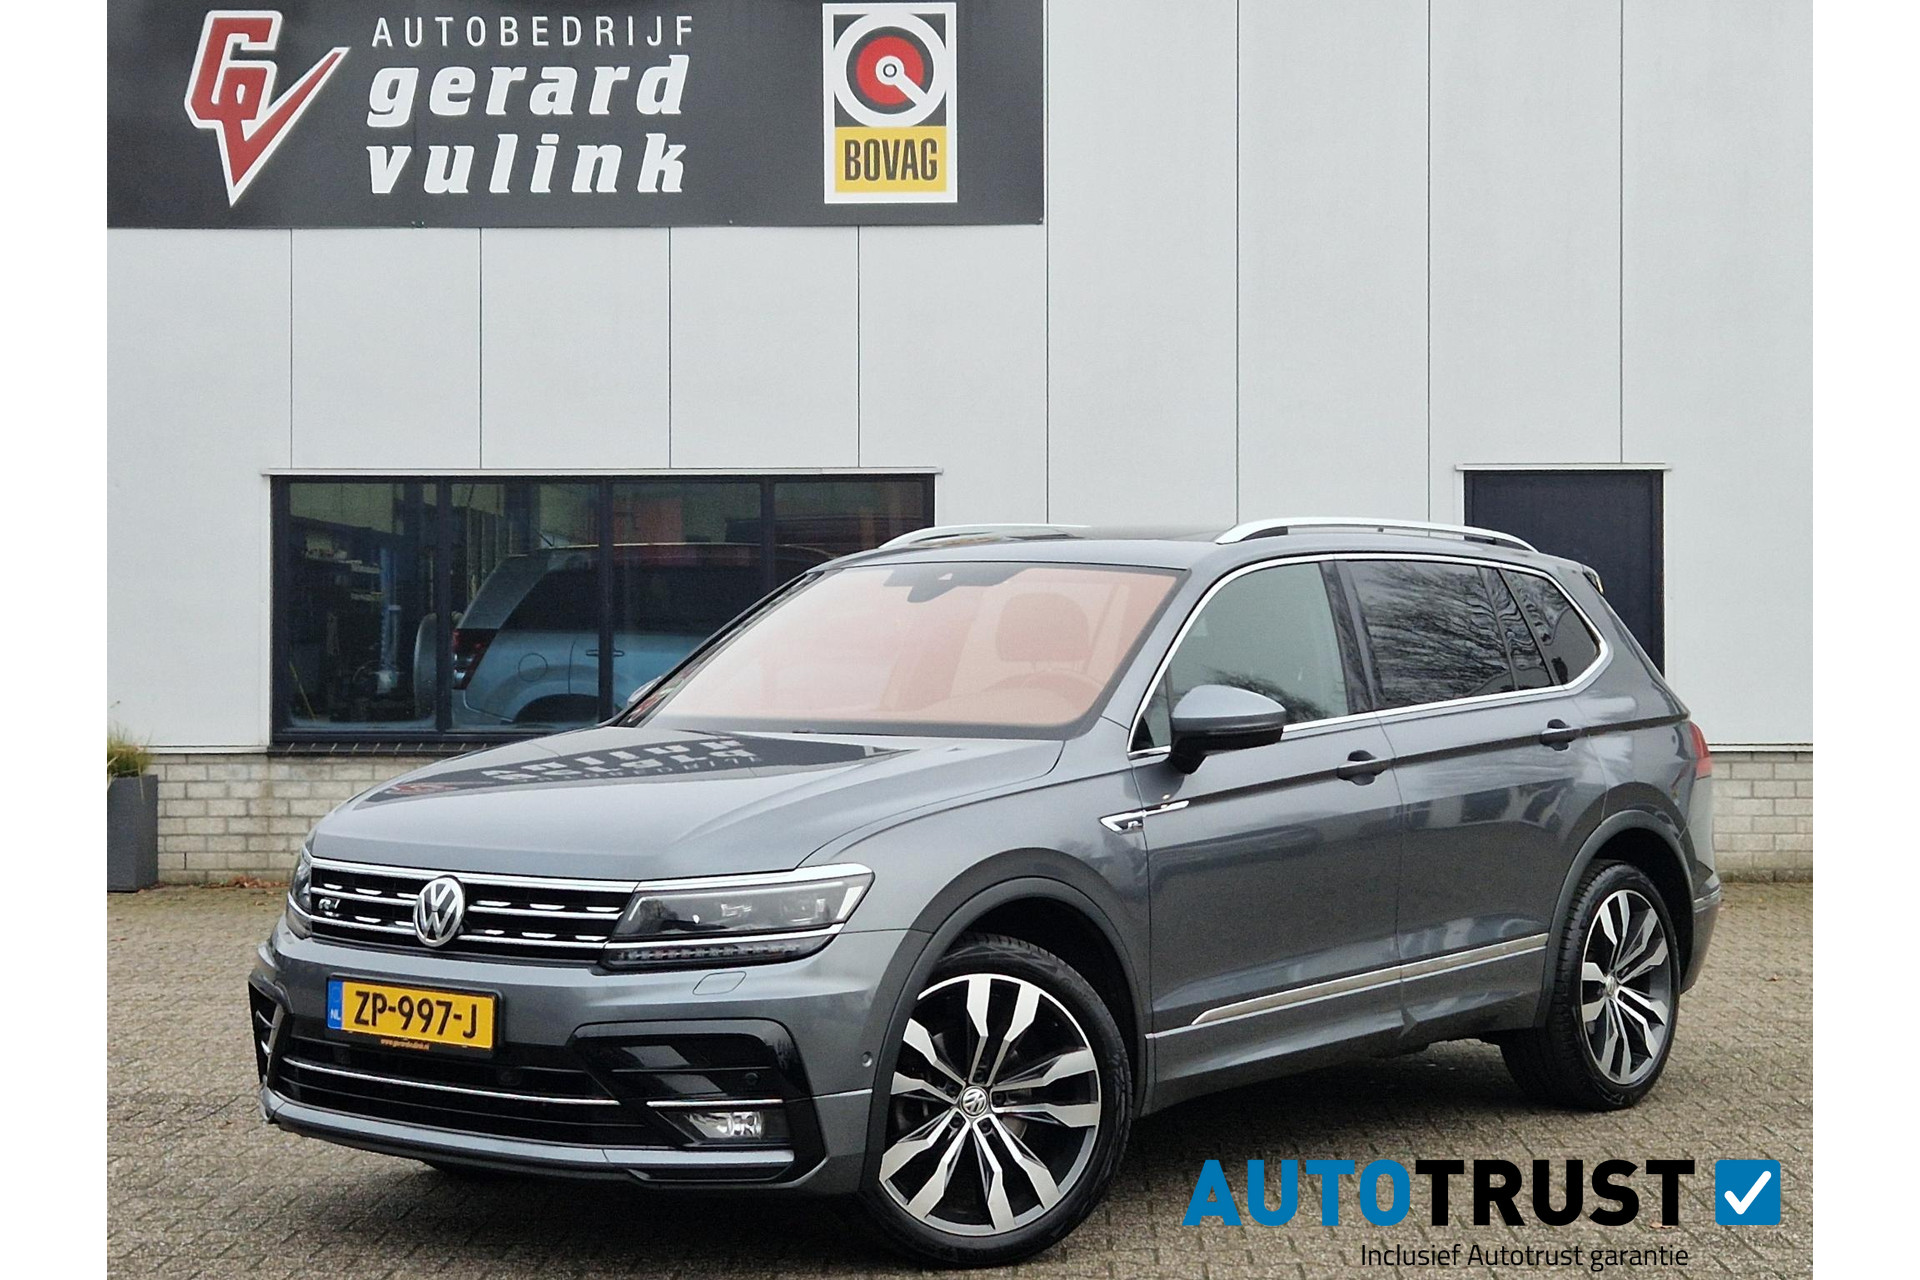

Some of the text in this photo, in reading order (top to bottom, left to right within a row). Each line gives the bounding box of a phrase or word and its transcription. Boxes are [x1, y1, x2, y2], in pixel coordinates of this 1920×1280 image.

[371, 16, 693, 48] AUTOBEDRIJF
[366, 54, 689, 127] gerard
[366, 132, 687, 195] vulink
[844, 138, 938, 181] BOVAG
[330, 1008, 341, 1021] NL
[354, 990, 477, 1039] ZP-997-J
